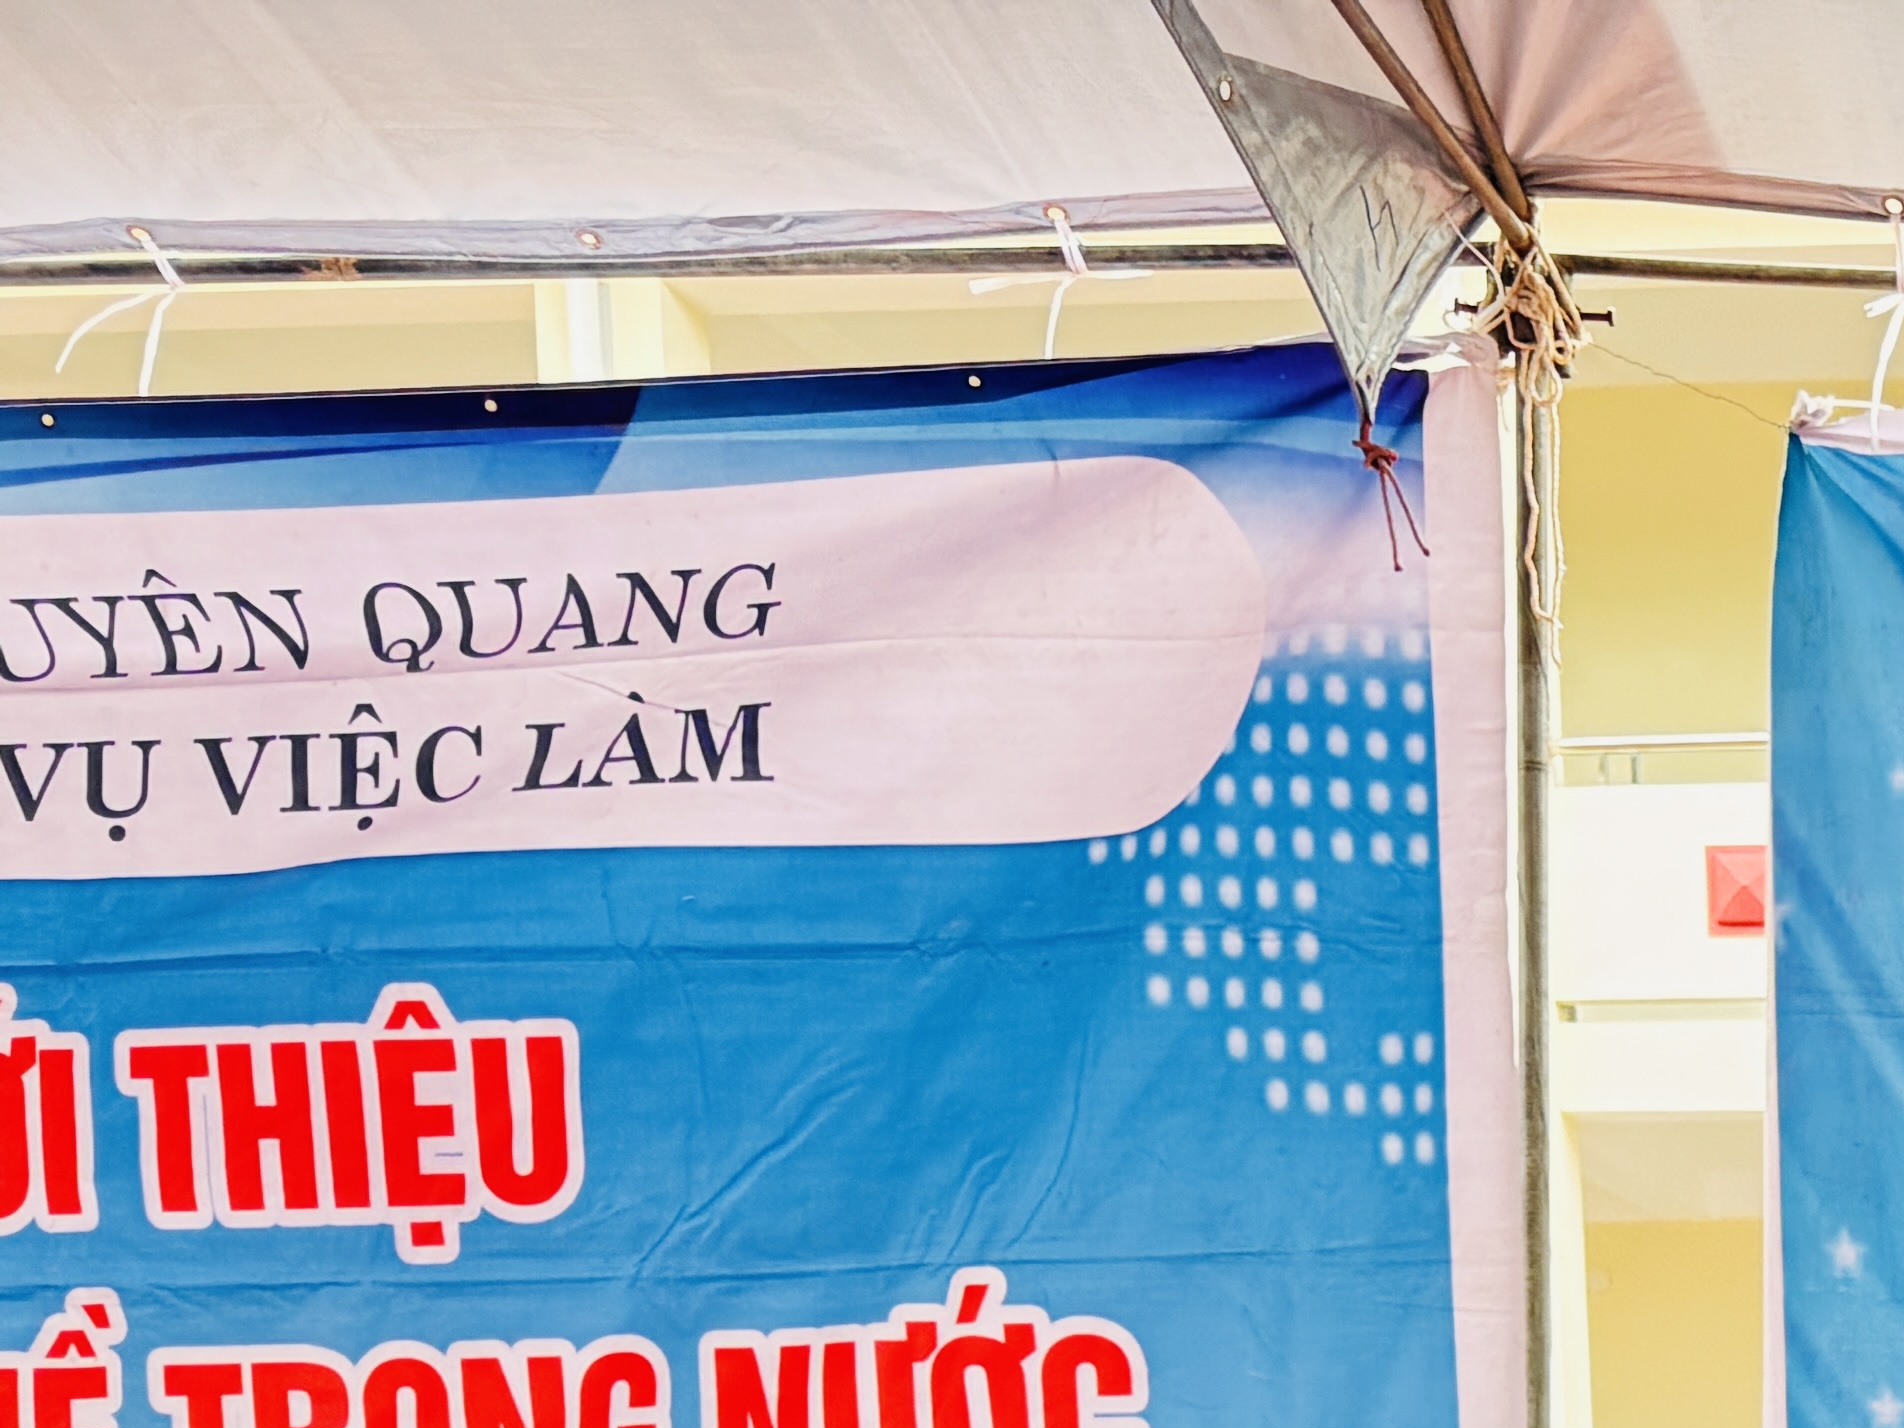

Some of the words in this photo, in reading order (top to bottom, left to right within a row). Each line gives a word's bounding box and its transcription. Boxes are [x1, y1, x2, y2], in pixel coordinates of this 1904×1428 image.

[364, 563, 781, 672] QUANG
[0, 741, 160, 841] VỤ
[194, 704, 481, 830] VIỆC
[522, 692, 773, 791] LÀM
[130, 1001, 567, 1246] THIỆU
